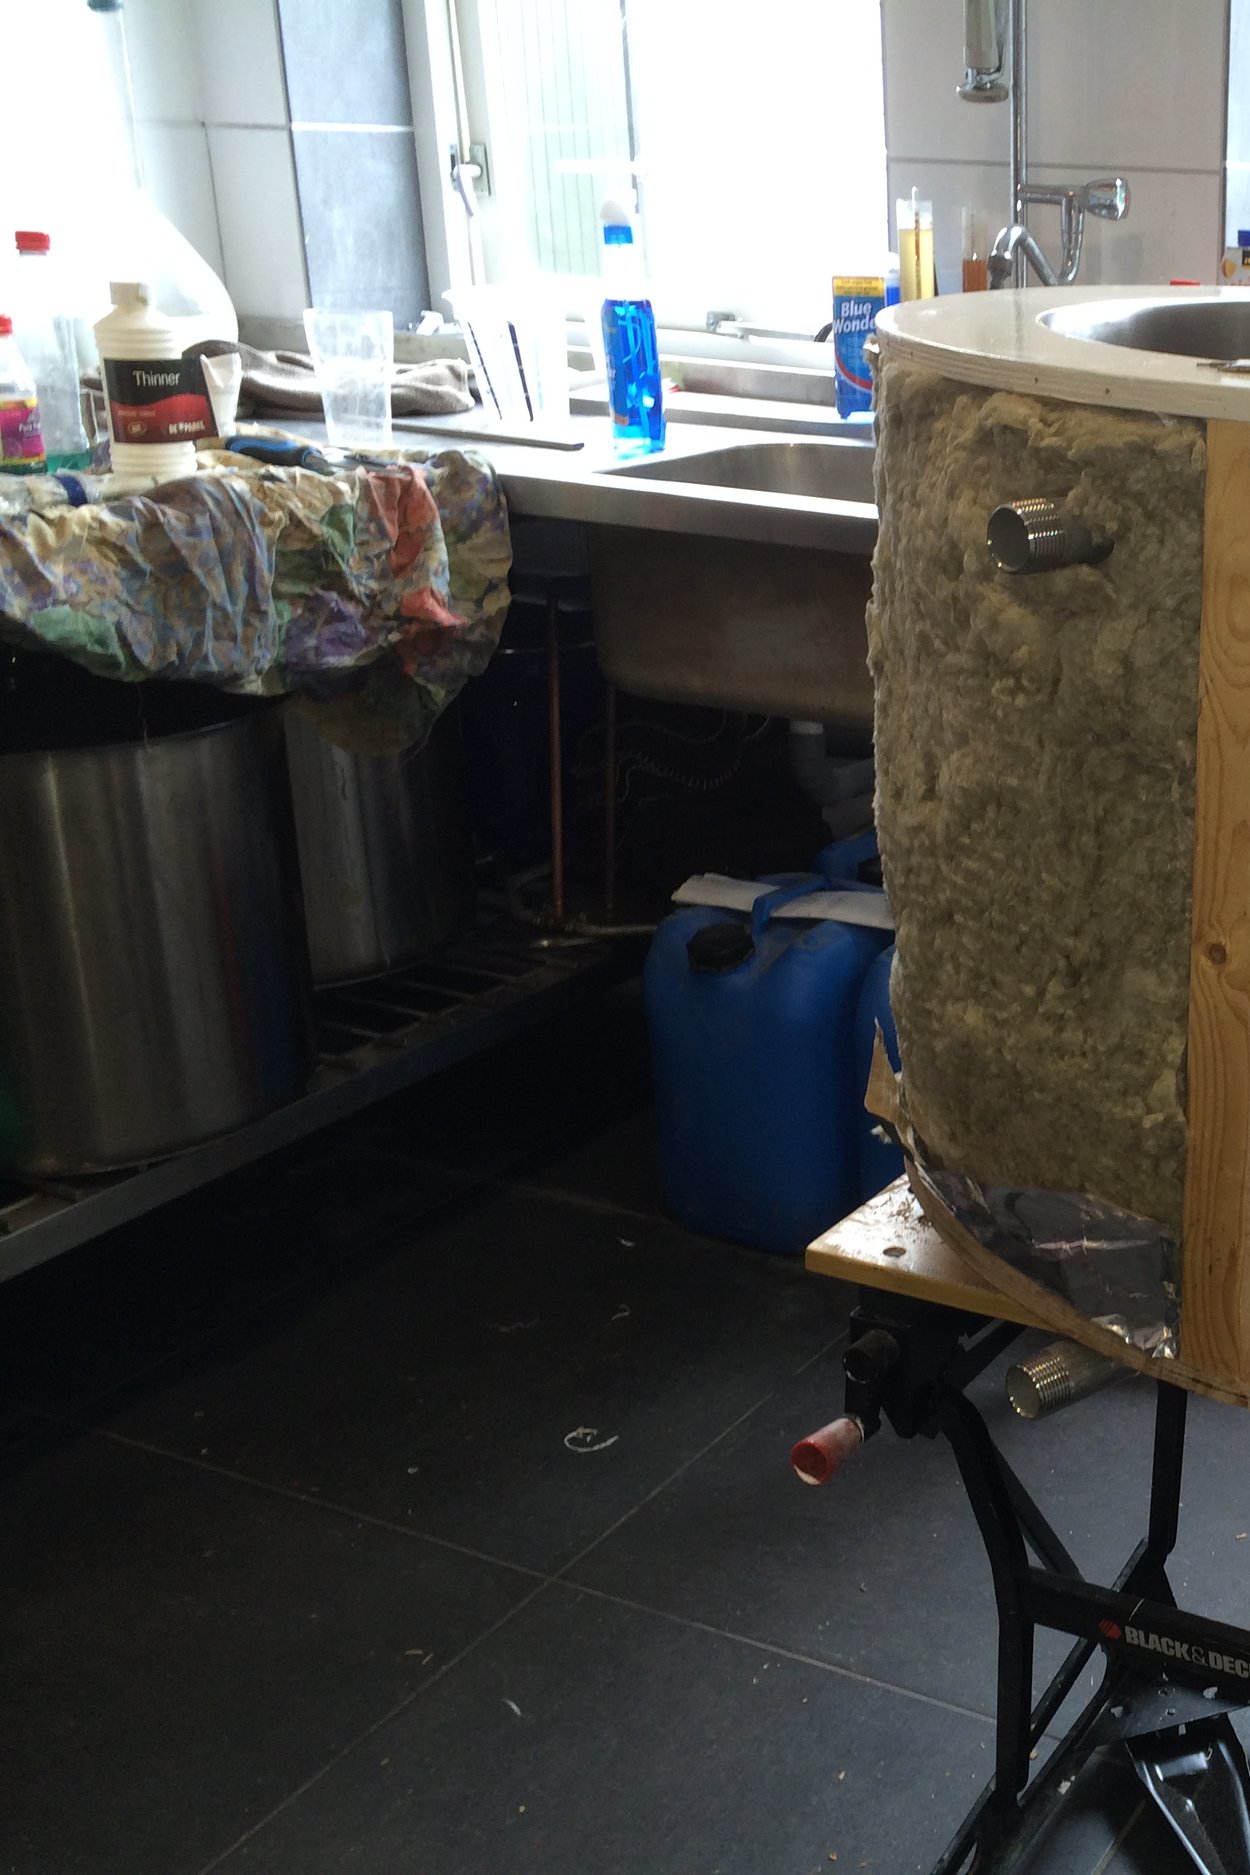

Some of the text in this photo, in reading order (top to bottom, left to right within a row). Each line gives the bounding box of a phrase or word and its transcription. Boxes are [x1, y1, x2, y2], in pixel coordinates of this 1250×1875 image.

[841, 299, 872, 317] Blue
[833, 314, 877, 334] Wonde
[132, 370, 180, 387] Thinner
